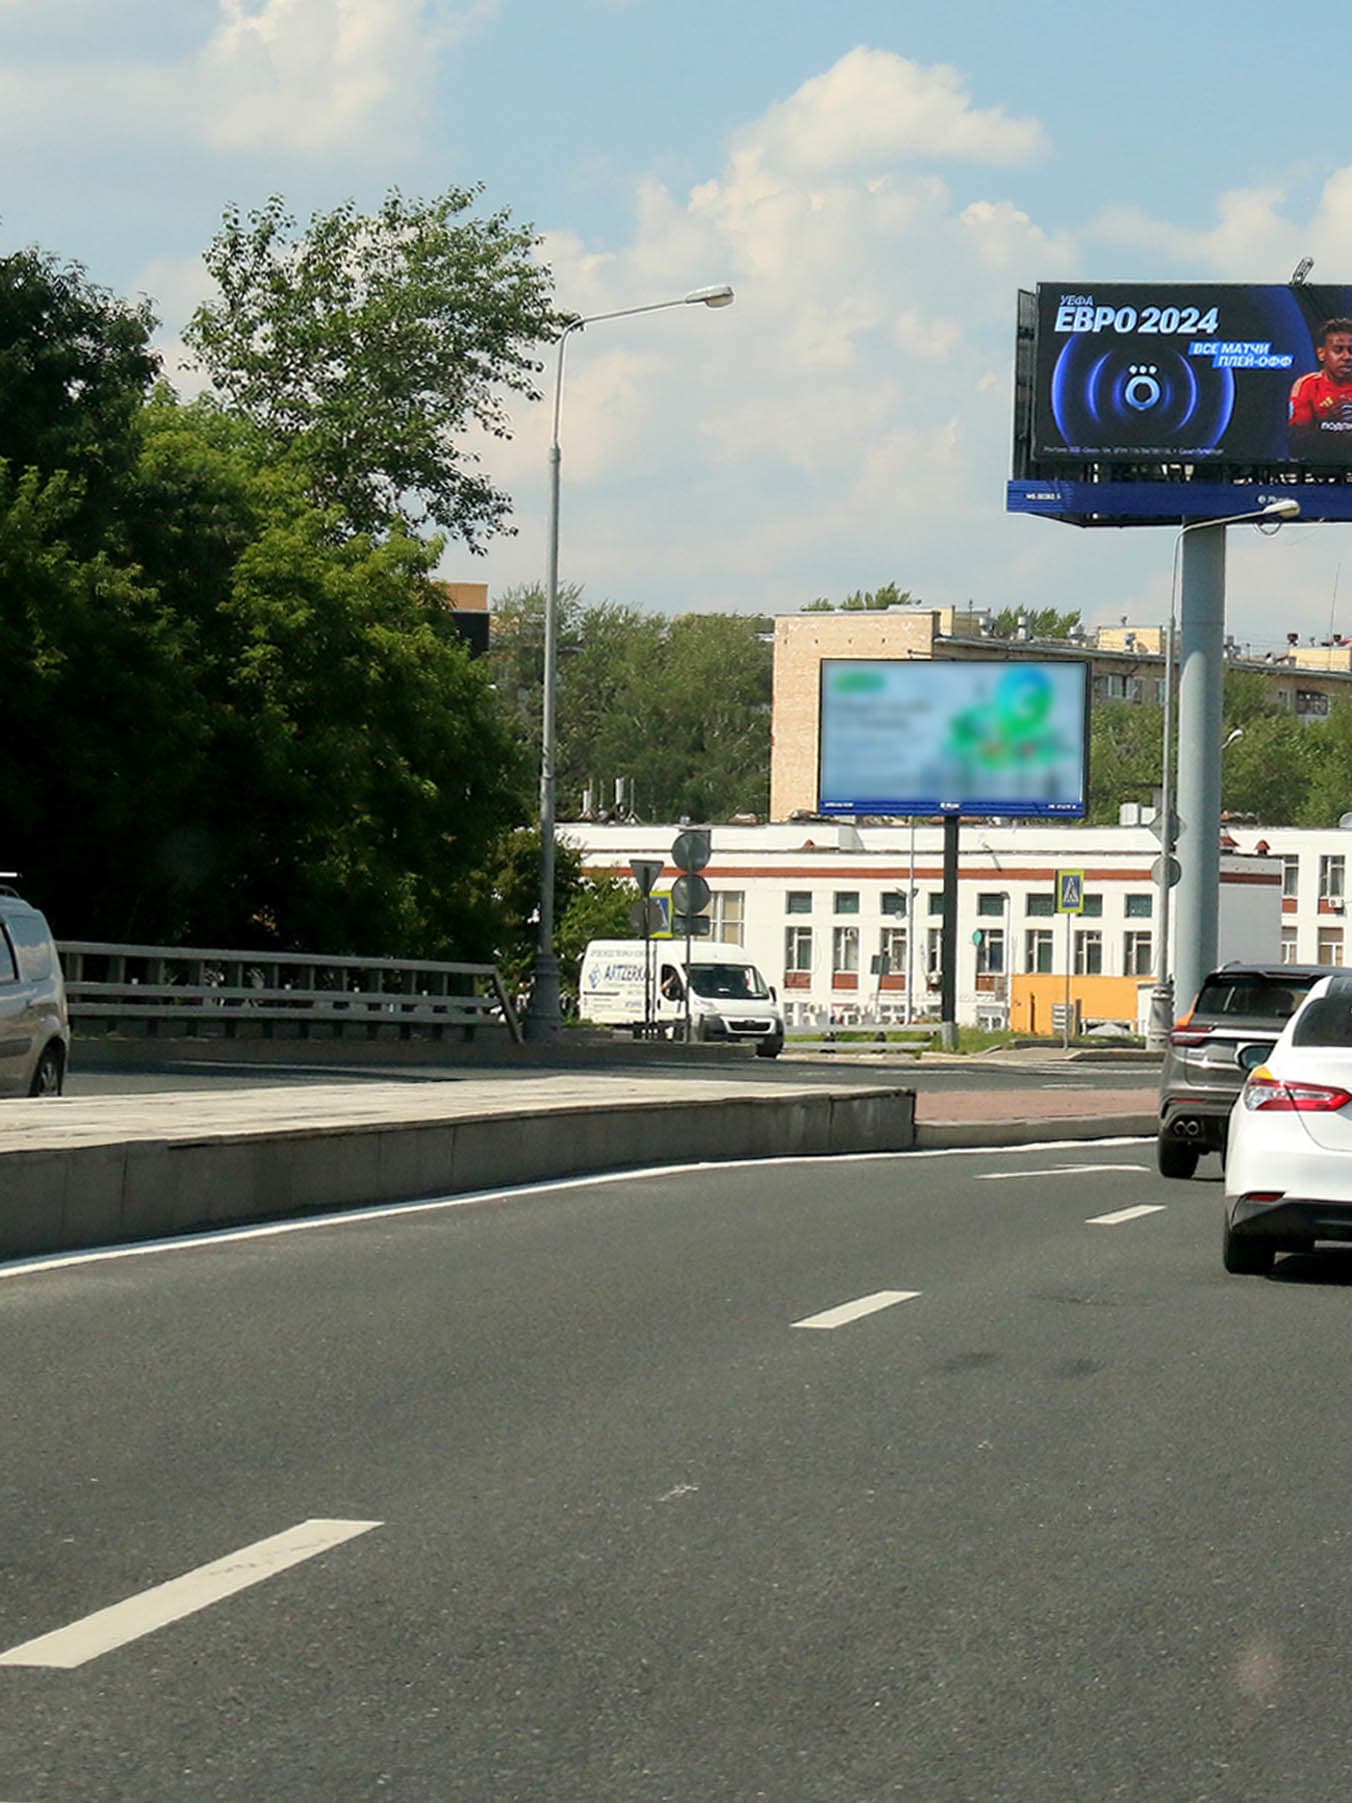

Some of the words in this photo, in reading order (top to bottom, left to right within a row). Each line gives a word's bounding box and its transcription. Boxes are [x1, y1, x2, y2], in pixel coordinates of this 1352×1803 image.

[1060, 295, 1093, 306] УЕФА
[1054, 307, 1137, 332] ЕВРО
[1138, 307, 1219, 333] 2024
[1193, 343, 1218, 354] ВСЕ
[1221, 343, 1270, 355] МАТЧИ
[1218, 355, 1293, 367] ПЛЕЙ-ОФФ
